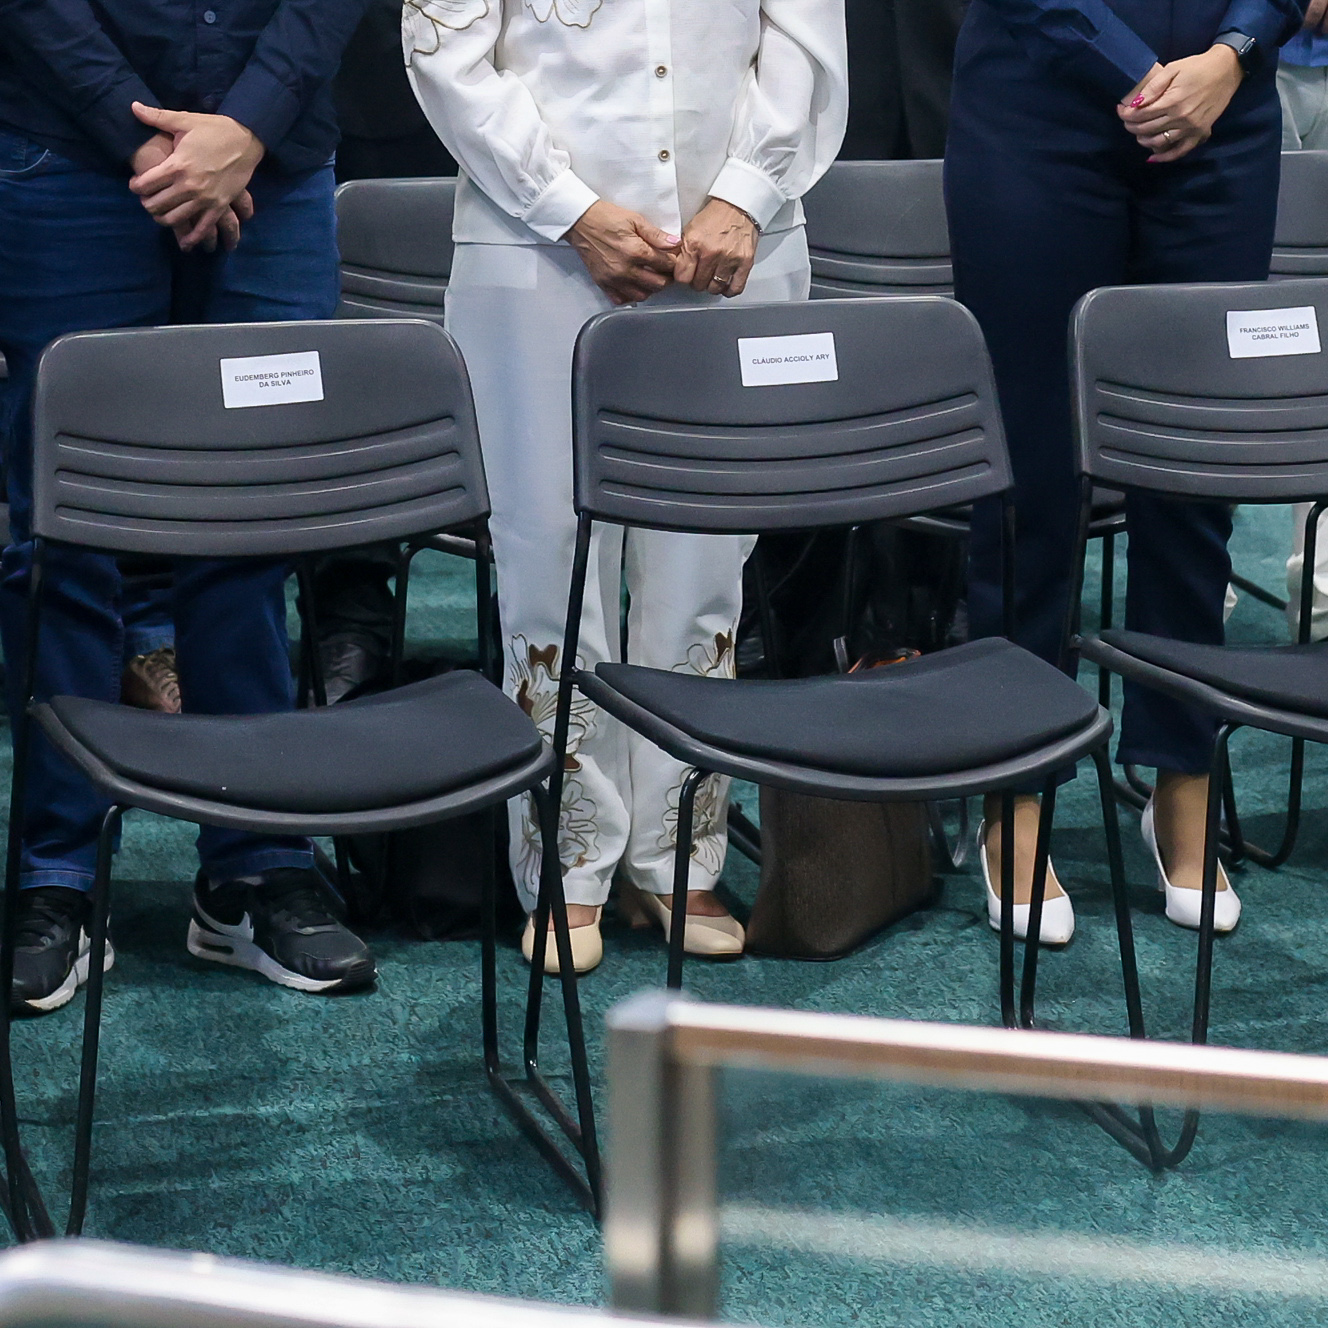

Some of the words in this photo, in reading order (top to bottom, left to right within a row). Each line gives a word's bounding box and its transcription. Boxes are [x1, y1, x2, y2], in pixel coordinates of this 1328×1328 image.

[1240, 325, 1277, 334] FRANCISCO
[1278, 323, 1310, 332] WILLIAMS
[1252, 333, 1278, 341] CABRAL
[1280, 331, 1300, 339] FILHO
[752, 357, 783, 365] CLÁUDIO
[784, 355, 814, 363] ACCIOLY
[234, 372, 279, 382] EUDEMBERG
[280, 369, 315, 379] PINHEIRO
[259, 380, 270, 388] DA
[271, 379, 292, 387] SILVA
